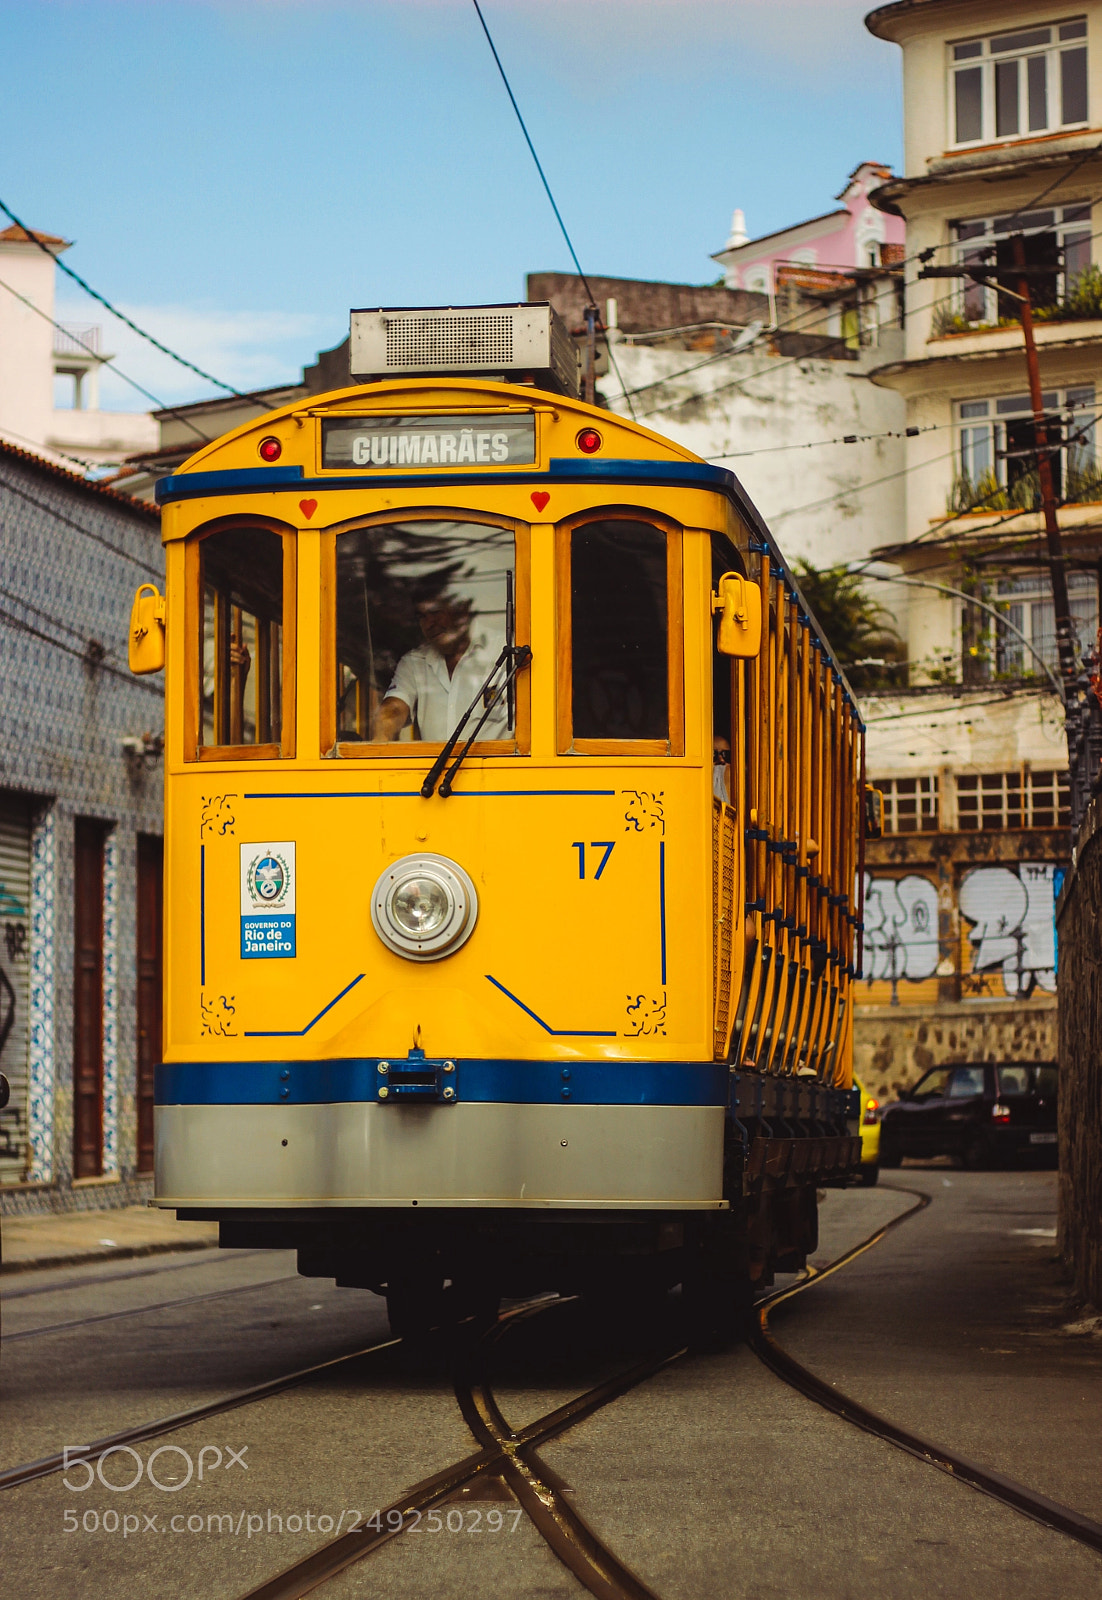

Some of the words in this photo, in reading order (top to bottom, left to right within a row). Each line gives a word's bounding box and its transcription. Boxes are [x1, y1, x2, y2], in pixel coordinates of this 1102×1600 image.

[352, 428, 509, 465] GUIMARÃES
[571, 841, 616, 880] 17
[244, 921, 279, 929] GOVERNO
[244, 929, 265, 941] Rio
[266, 928, 282, 940] de
[244, 939, 292, 952] Janeiro
